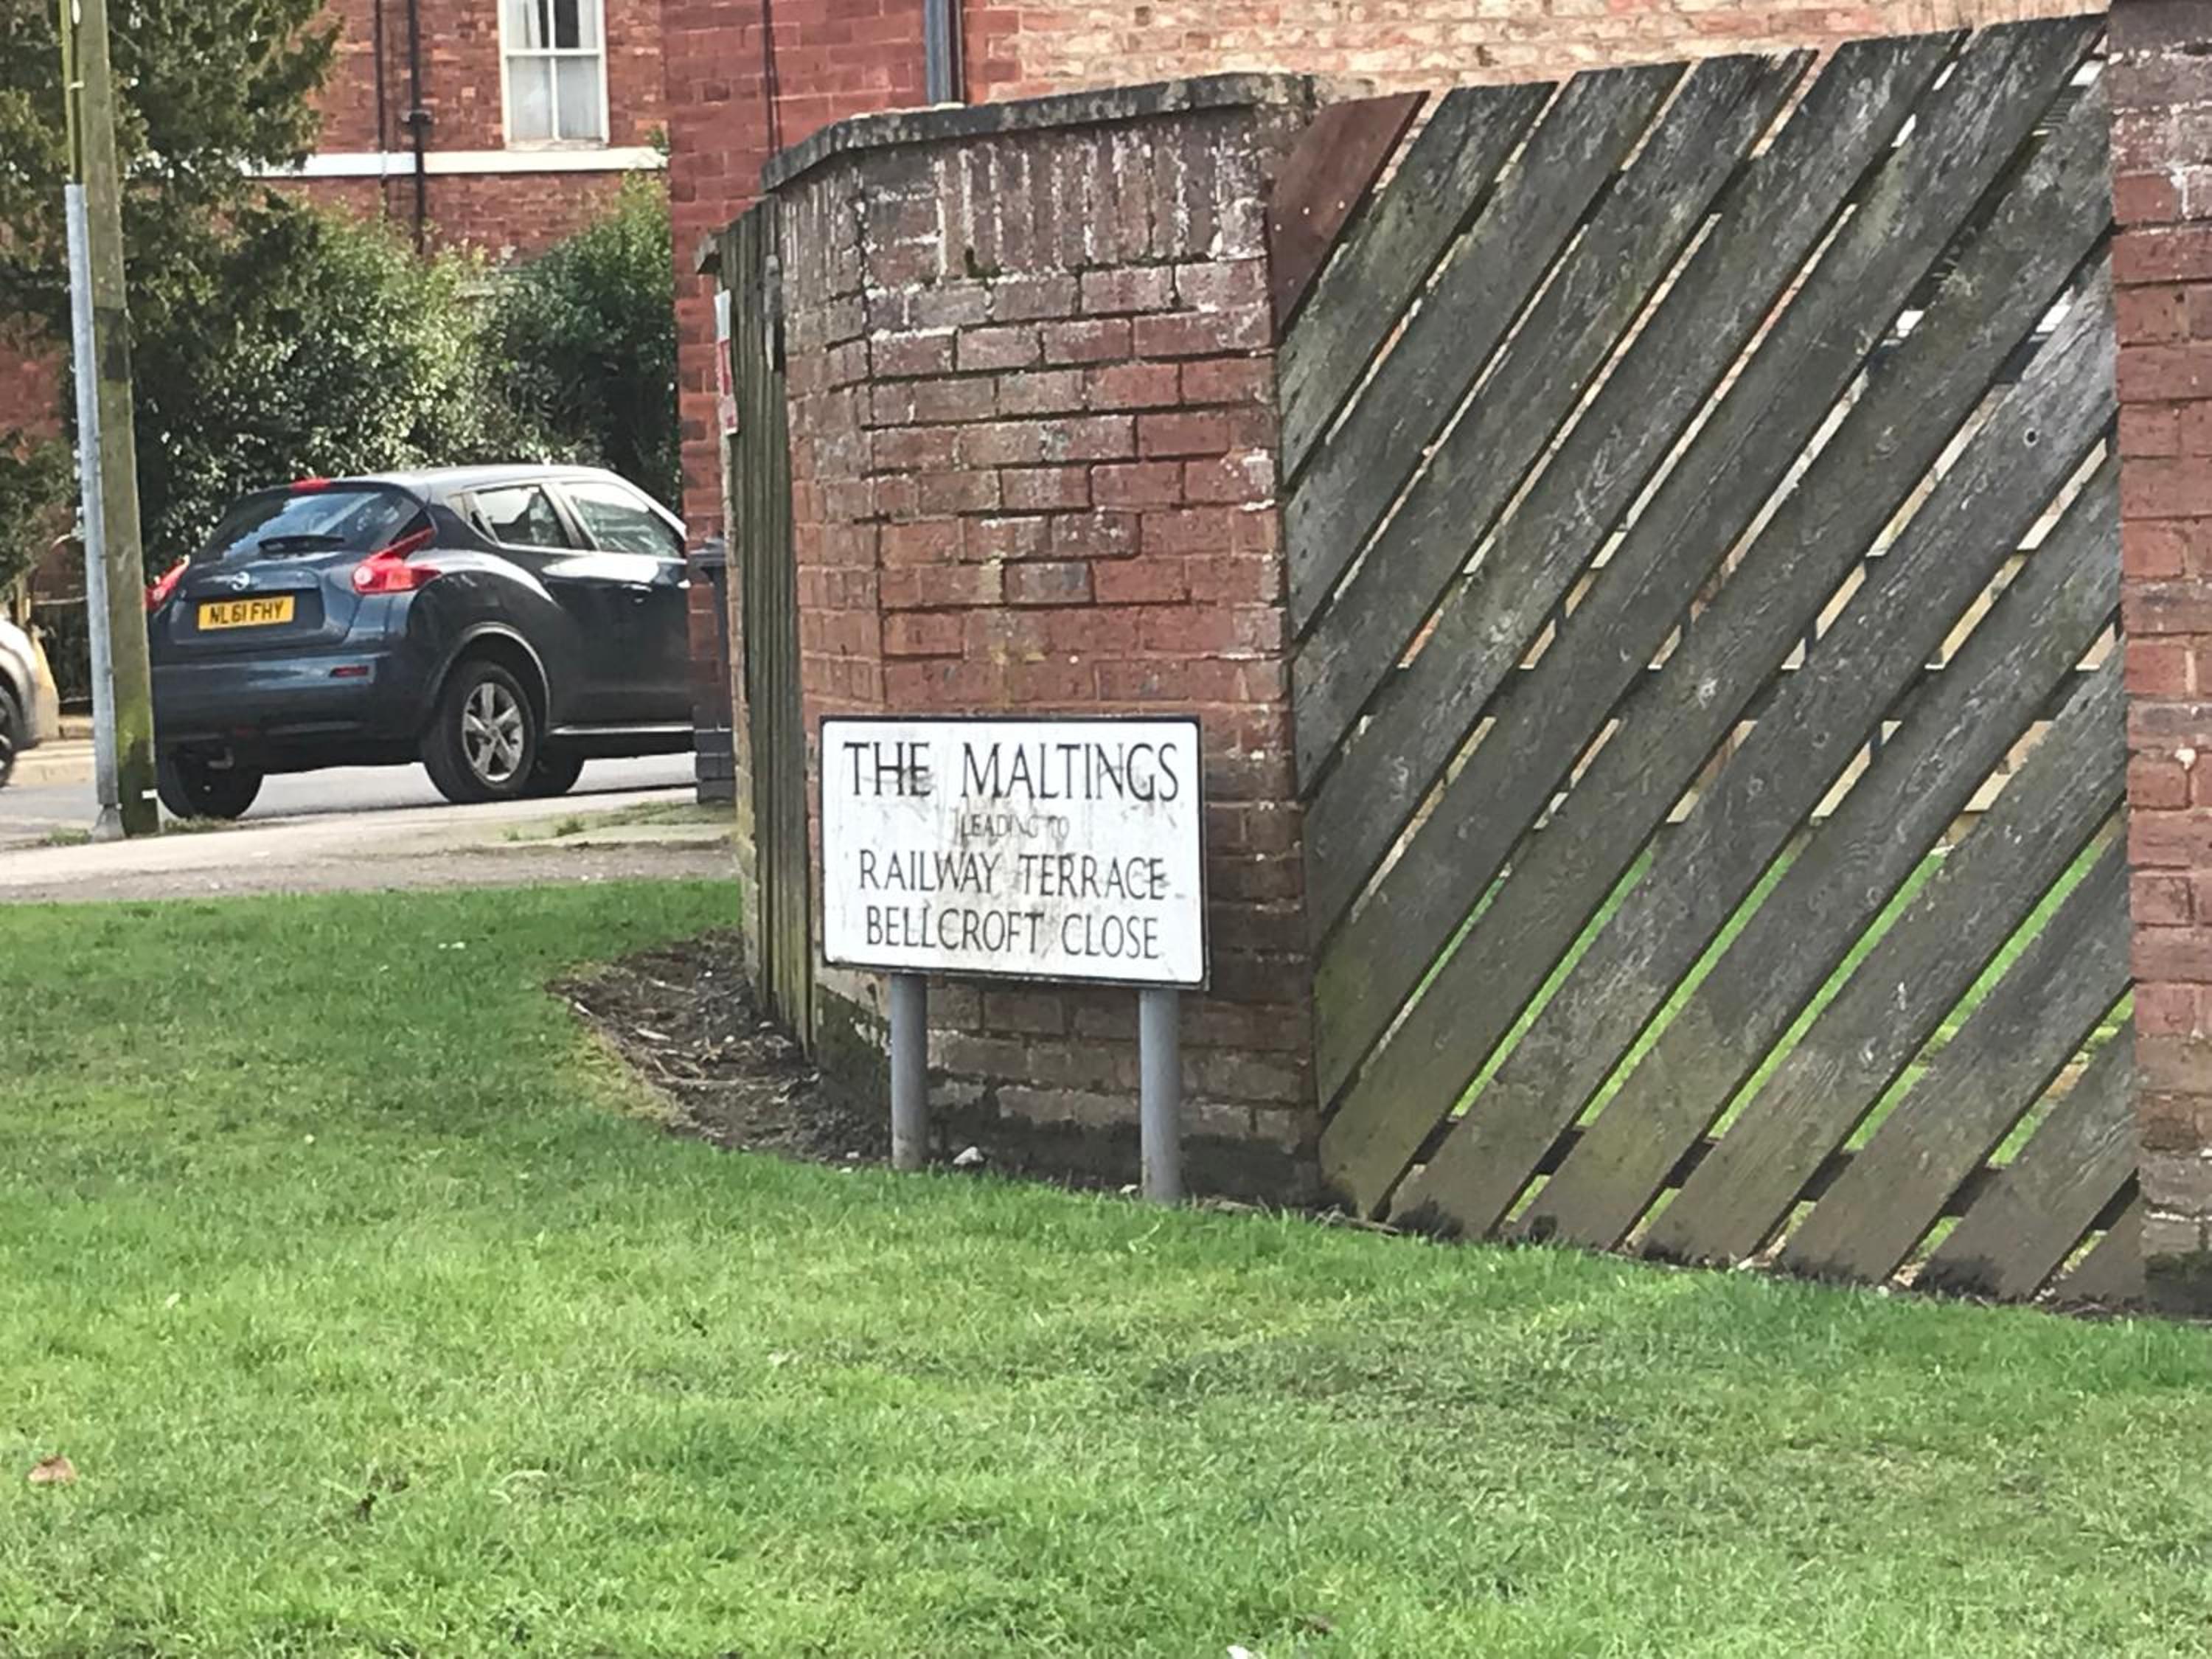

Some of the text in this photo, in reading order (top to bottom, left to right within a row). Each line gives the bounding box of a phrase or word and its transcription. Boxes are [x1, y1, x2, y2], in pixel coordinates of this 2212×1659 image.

[250, 601, 284, 621] FHY
[844, 742, 1180, 801] THE MALTINGS
[960, 813, 1070, 840] LEADING TO
[859, 849, 1166, 900] RAILWAY TERRACE
[866, 905, 1161, 959] BELLCROFT CLOSE
